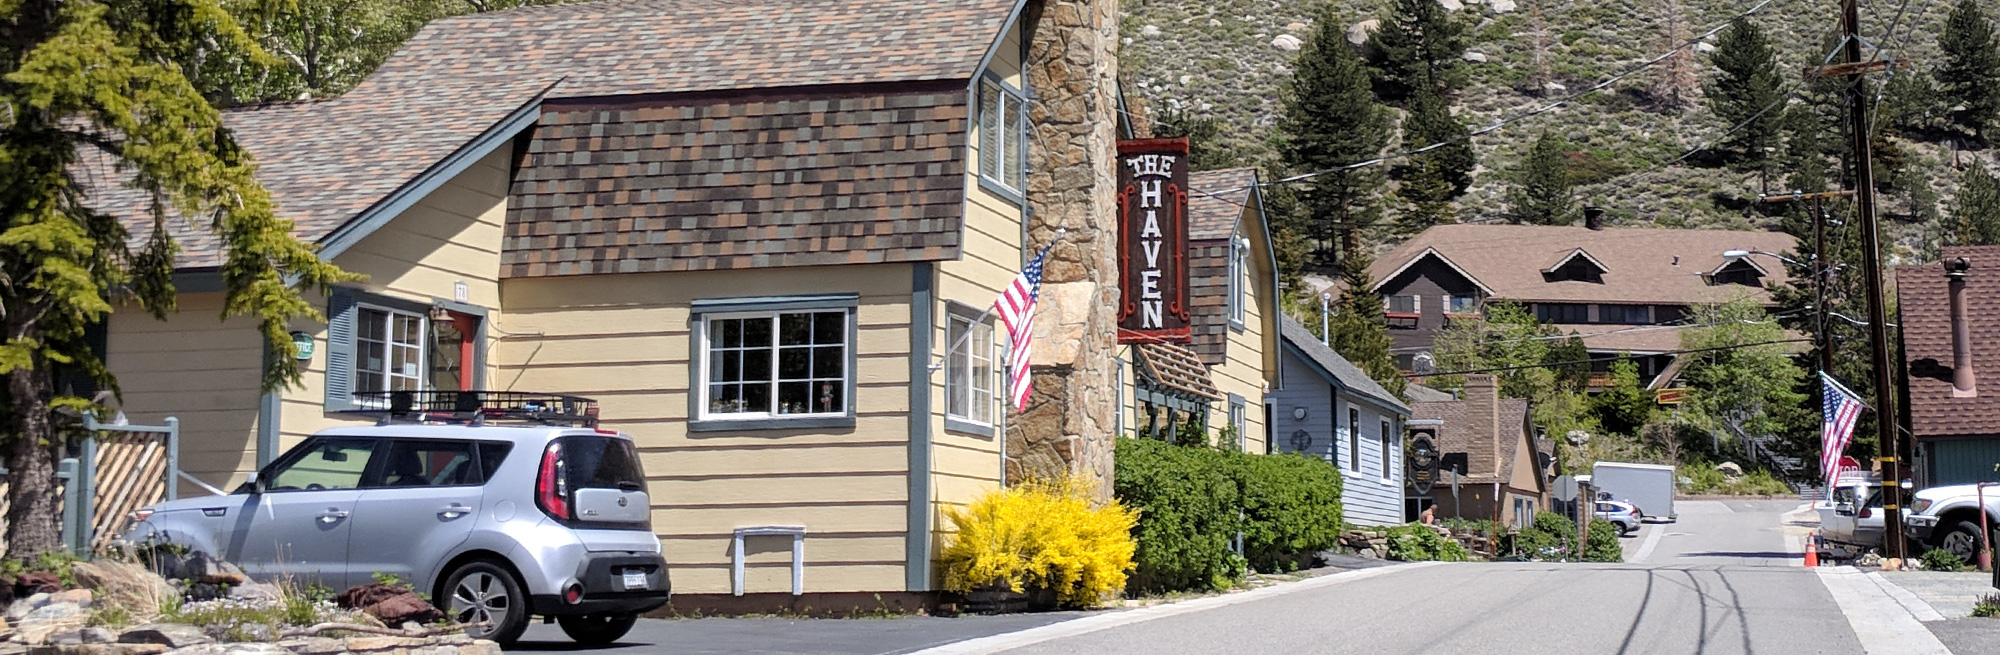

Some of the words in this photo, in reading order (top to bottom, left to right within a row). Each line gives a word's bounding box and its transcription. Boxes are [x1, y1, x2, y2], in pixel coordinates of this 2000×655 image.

[1126, 154, 1176, 179] THE
[1140, 180, 1164, 329] HAVEN
[293, 341, 313, 353] FFICE
[1839, 465, 1859, 477] TOP
